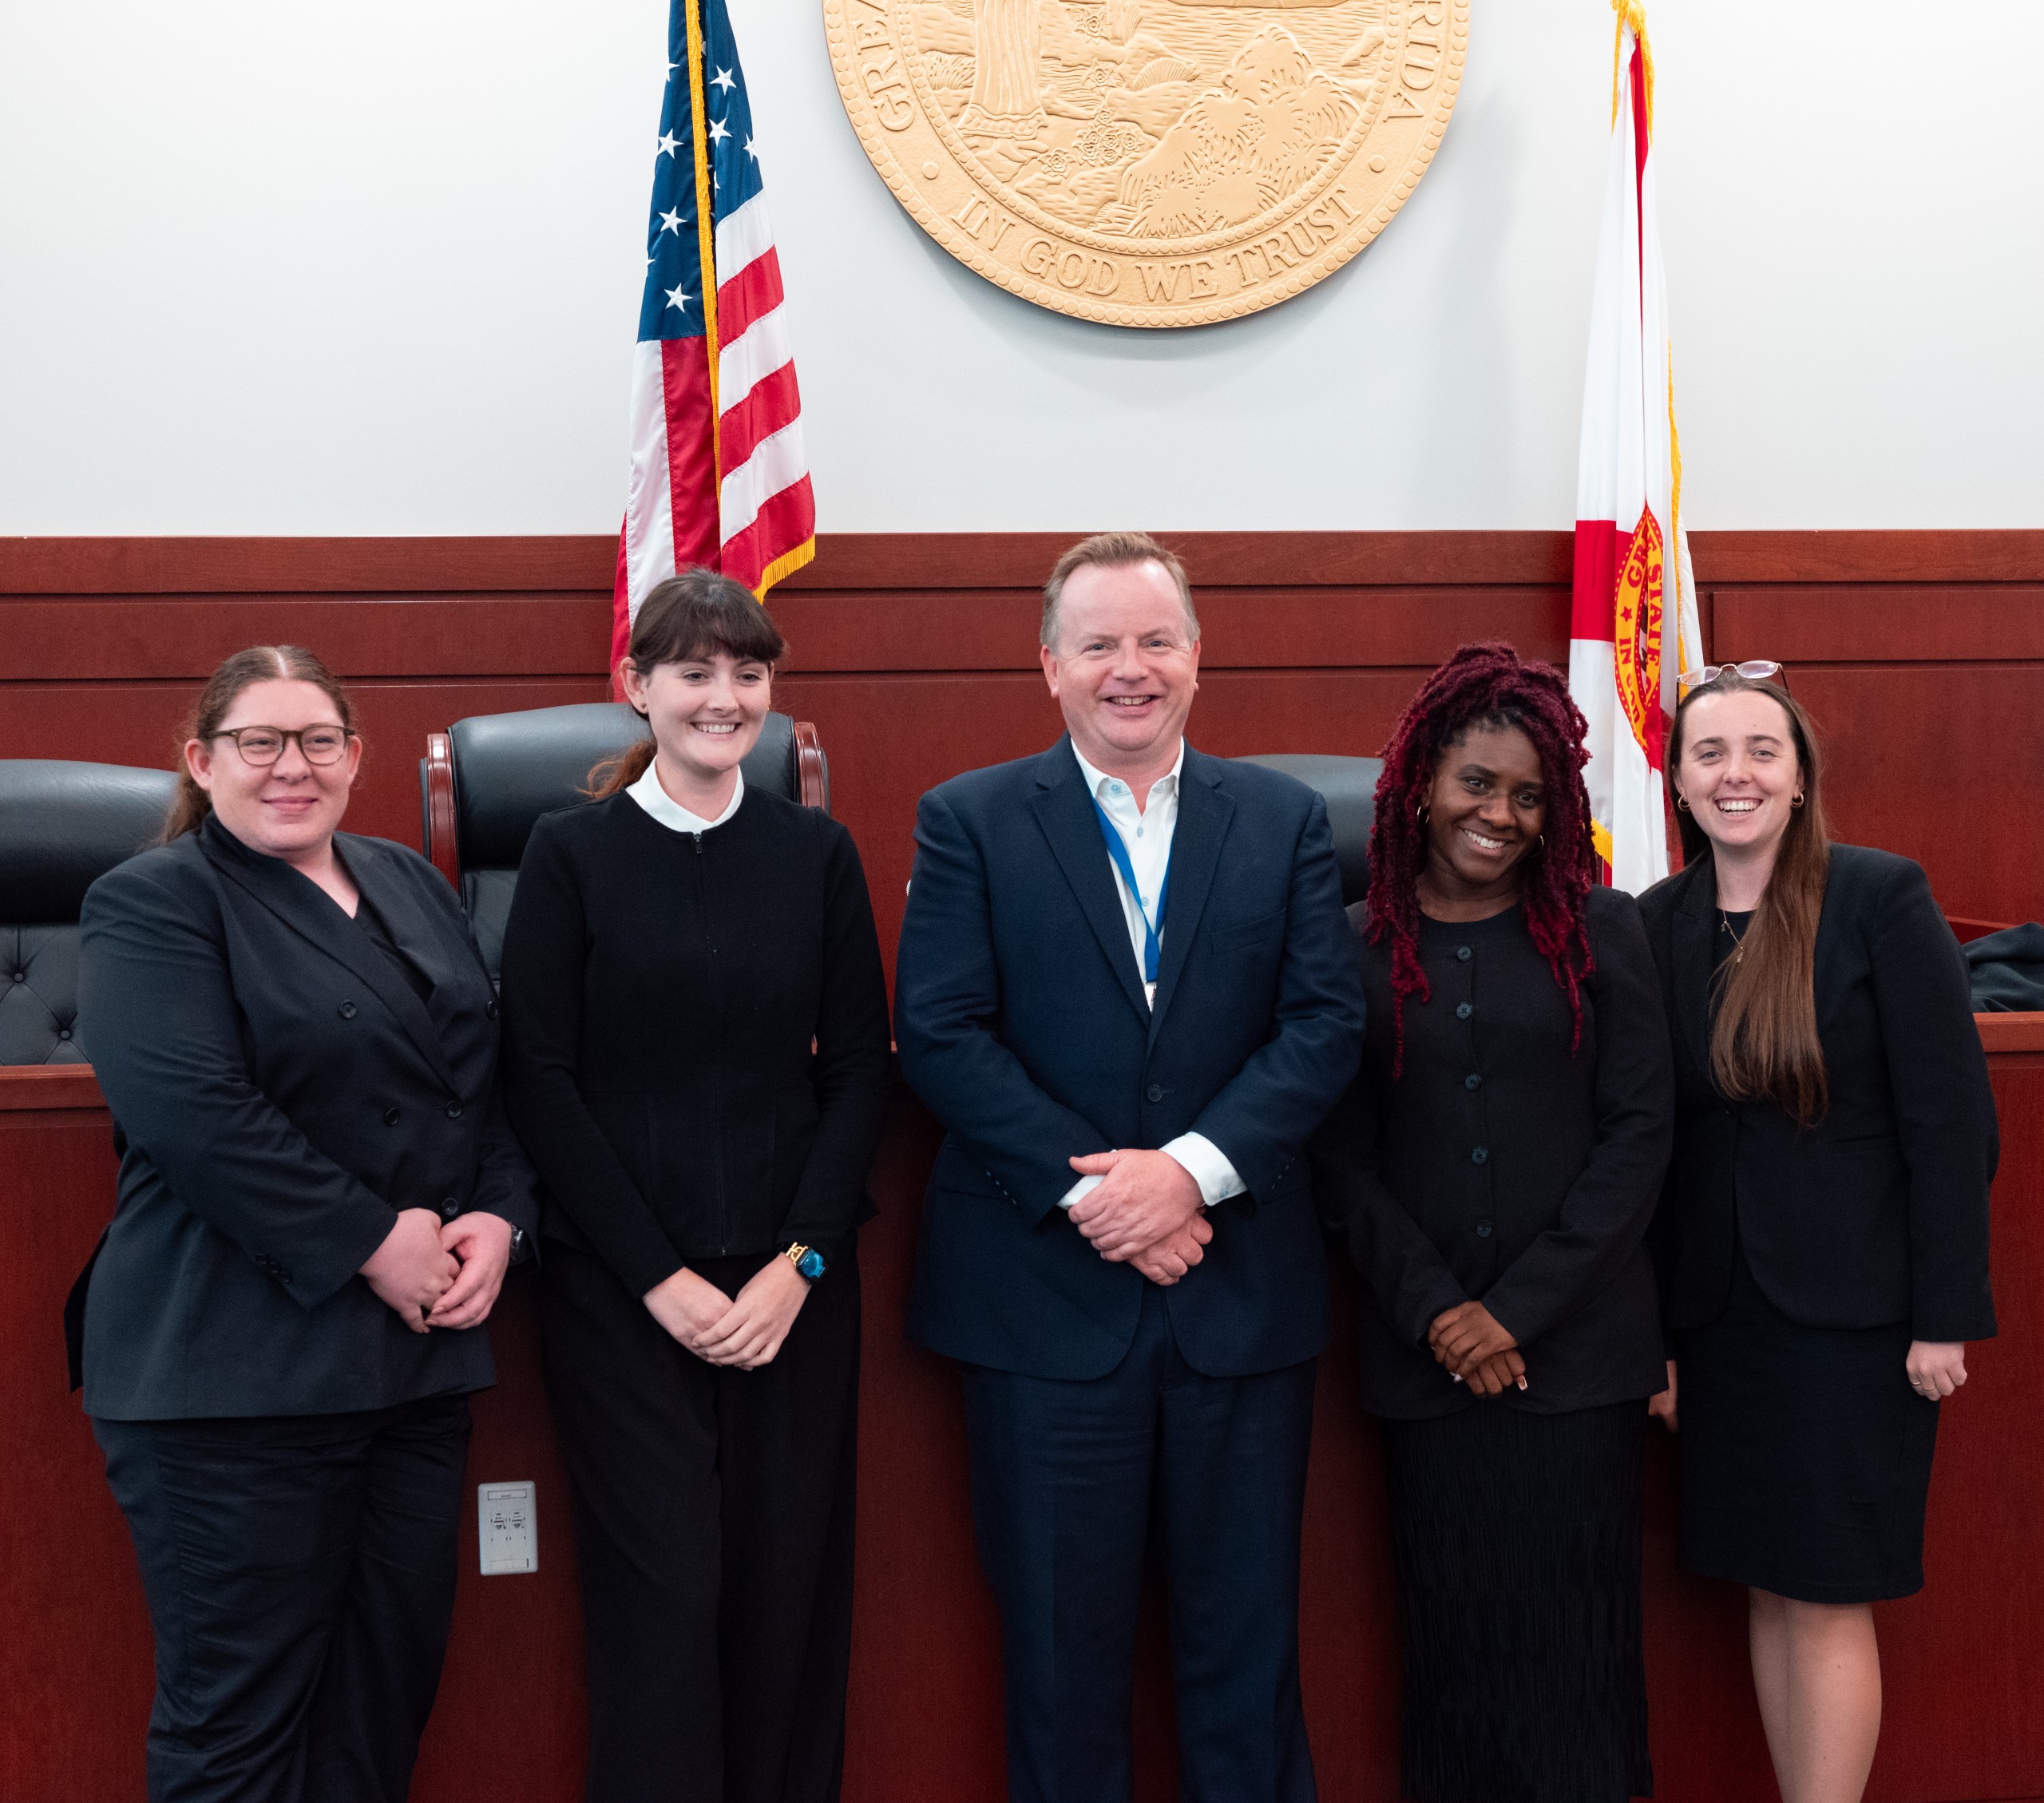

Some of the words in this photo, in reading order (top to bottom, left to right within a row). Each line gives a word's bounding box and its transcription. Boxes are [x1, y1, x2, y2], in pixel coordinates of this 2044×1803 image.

[949, 192, 1016, 251] IN
[1020, 237, 1119, 297] GOD
[1138, 261, 1218, 302] WE
[1226, 188, 1362, 287] TRUST
[1646, 563, 1663, 667] STATE
